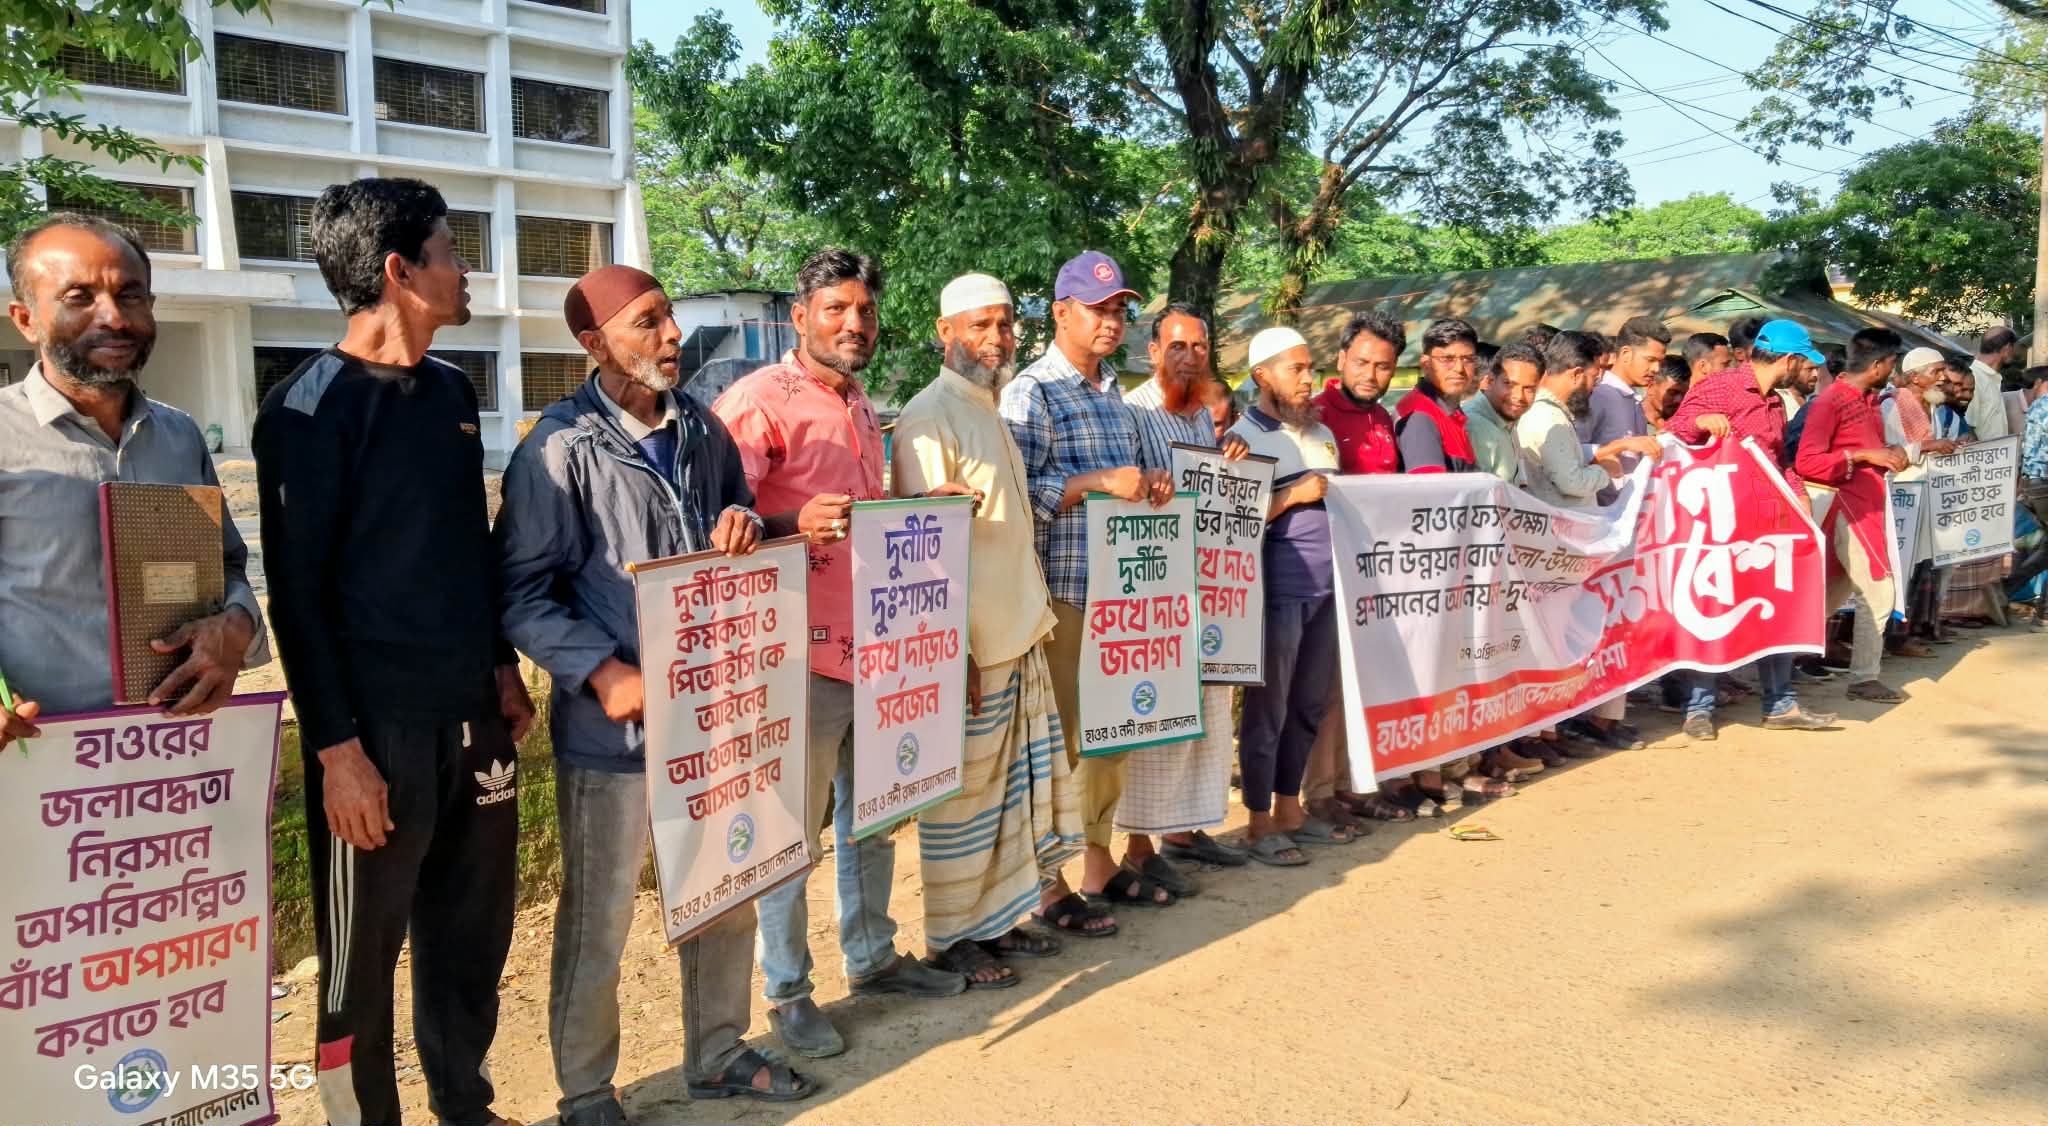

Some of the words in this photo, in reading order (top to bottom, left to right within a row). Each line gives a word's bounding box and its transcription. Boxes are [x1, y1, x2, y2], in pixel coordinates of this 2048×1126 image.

[1181, 461, 1214, 497] পানি
[1217, 468, 1262, 506] উন্নয়ন
[1106, 513, 1181, 547] প্রশাসনের
[1411, 505, 1468, 536] হাওরে
[1936, 506, 1977, 527] করতে
[1980, 502, 2006, 521] হবে
[1118, 545, 1168, 595] দুর্নীতি
[1224, 549, 1256, 583] দাও
[1356, 540, 1394, 579] পানি
[1399, 541, 1461, 580] উন্নয়ন
[673, 566, 779, 624] দুর্নীতিবাজ
[871, 577, 950, 637] দুঃশাসন
[1089, 598, 1149, 641] রুখে
[1152, 594, 1191, 631] দাও
[1197, 585, 1248, 620] নগণ
[675, 600, 758, 654] কর্মকর্তা
[761, 607, 777, 633] ও
[858, 638, 901, 685] রুখে
[903, 620, 959, 673] দাঁড়াও
[667, 642, 756, 699] পিআইসি
[760, 641, 787, 672] কে
[1100, 634, 1182, 677] জনগণ
[695, 682, 768, 735] আইনের
[875, 676, 940, 731] সর্বজন
[1085, 727, 1109, 745] হাওর
[1110, 726, 1118, 738] ও
[1119, 718, 1136, 738] নদী
[1137, 720, 1158, 738] রক্ষা
[1159, 714, 1198, 733] আন্দোলন
[1427, 711, 1442, 742] ও
[74, 718, 213, 769] হাওরের
[666, 735, 753, 786] আওতায়
[755, 716, 791, 754] নিয়ে
[40, 768, 235, 828] জলাবদ্ধতা
[476, 788, 515, 806] adidas
[686, 772, 750, 824] আসতে
[752, 757, 782, 794] হবে
[857, 797, 878, 821] হাওর
[879, 796, 887, 812] ও
[887, 783, 902, 808] নদী
[902, 780, 922, 803] রক্ষা
[921, 765, 957, 796] আন্দোলন
[67, 825, 213, 883] নিরসনে
[15, 868, 248, 949] অপরিকল্পিত
[671, 894, 701, 929] হাওর
[702, 891, 712, 908] ও
[713, 873, 733, 904] নদী
[734, 868, 758, 894] রক্ষা
[758, 840, 804, 882] আন্দোলন
[0, 958, 72, 1010] বাঁধ
[80, 916, 260, 993] অপসারণ
[35, 1000, 161, 1058] করতে
[168, 980, 228, 1029] হবে
